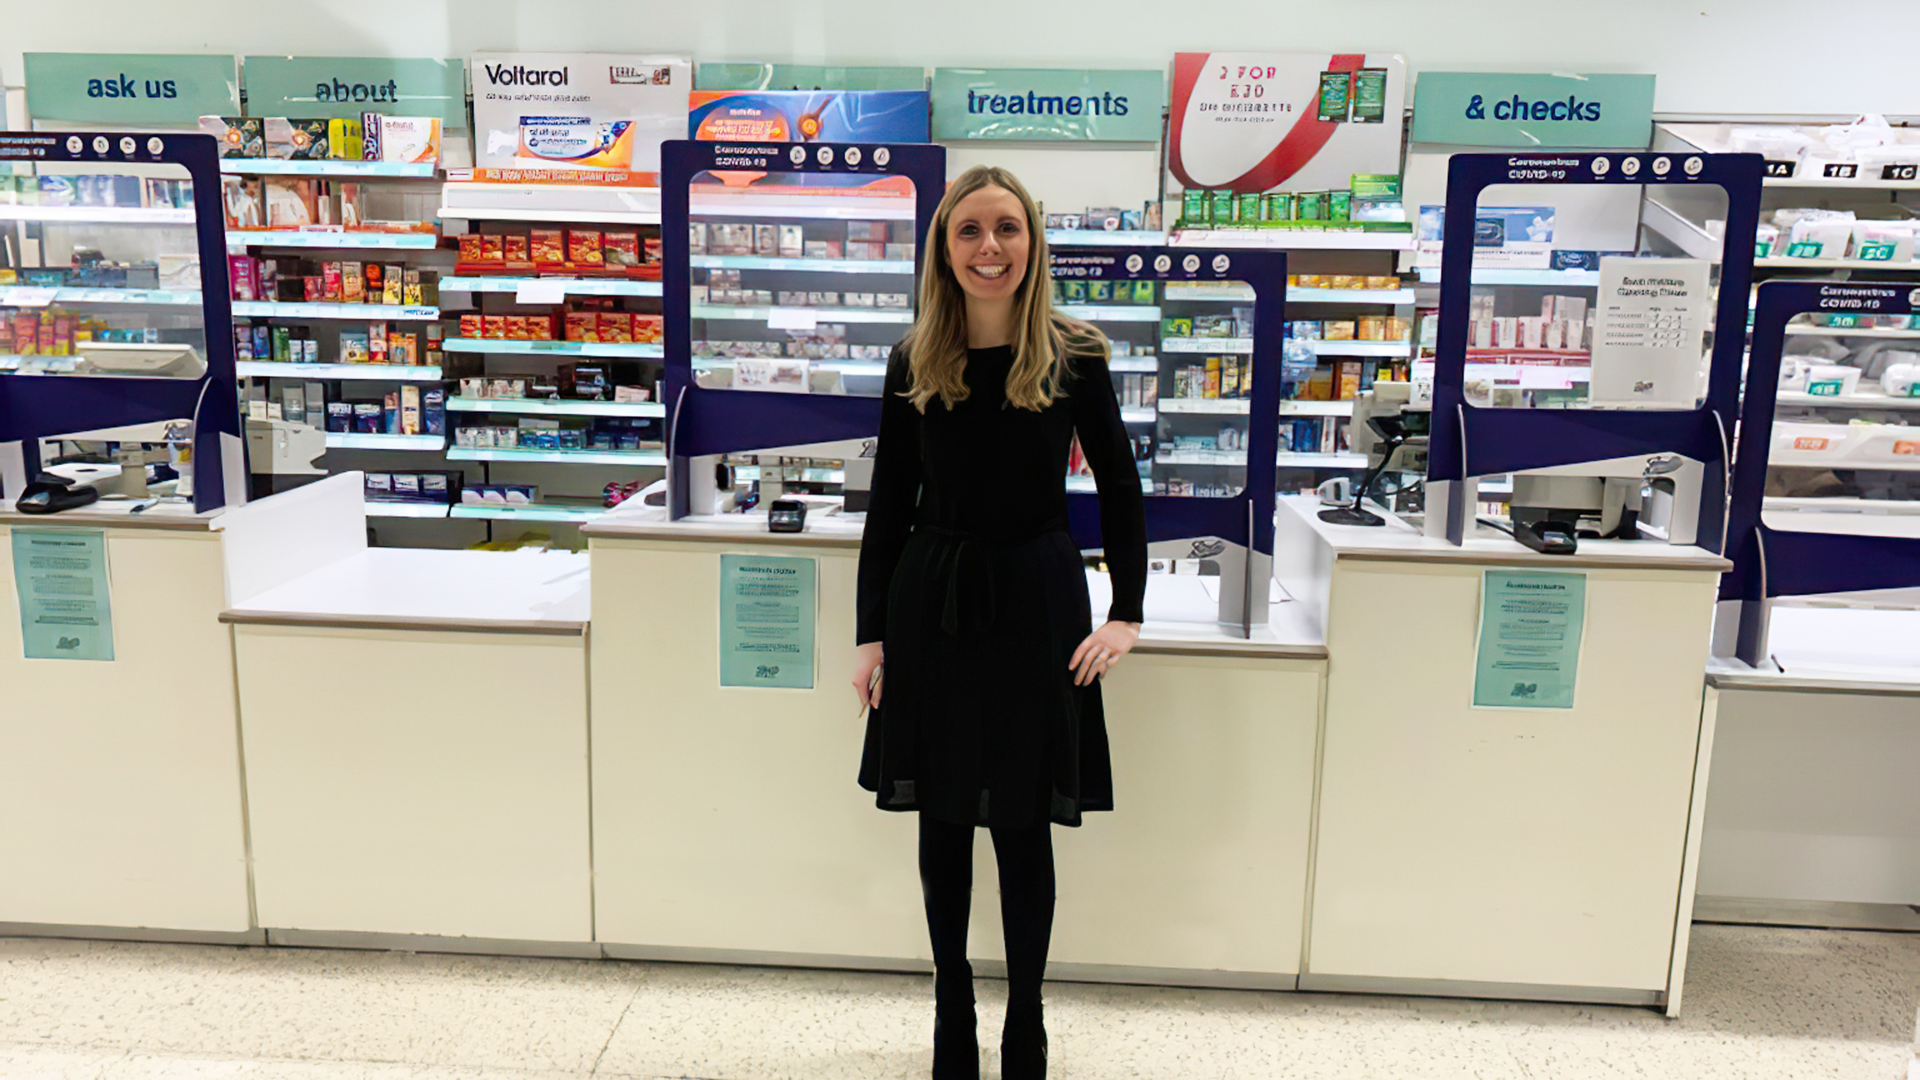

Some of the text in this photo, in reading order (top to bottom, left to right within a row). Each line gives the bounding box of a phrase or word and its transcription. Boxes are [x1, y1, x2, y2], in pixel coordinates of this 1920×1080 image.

[87, 74, 177, 99] ask us
[485, 64, 568, 86] Voltarol
[315, 77, 398, 103] about
[968, 89, 1128, 116] treatments
[1465, 94, 1601, 121] & checks
[1767, 164, 1788, 175] 1A
[1829, 166, 1852, 178] 1B
[1892, 167, 1914, 179] 1C
